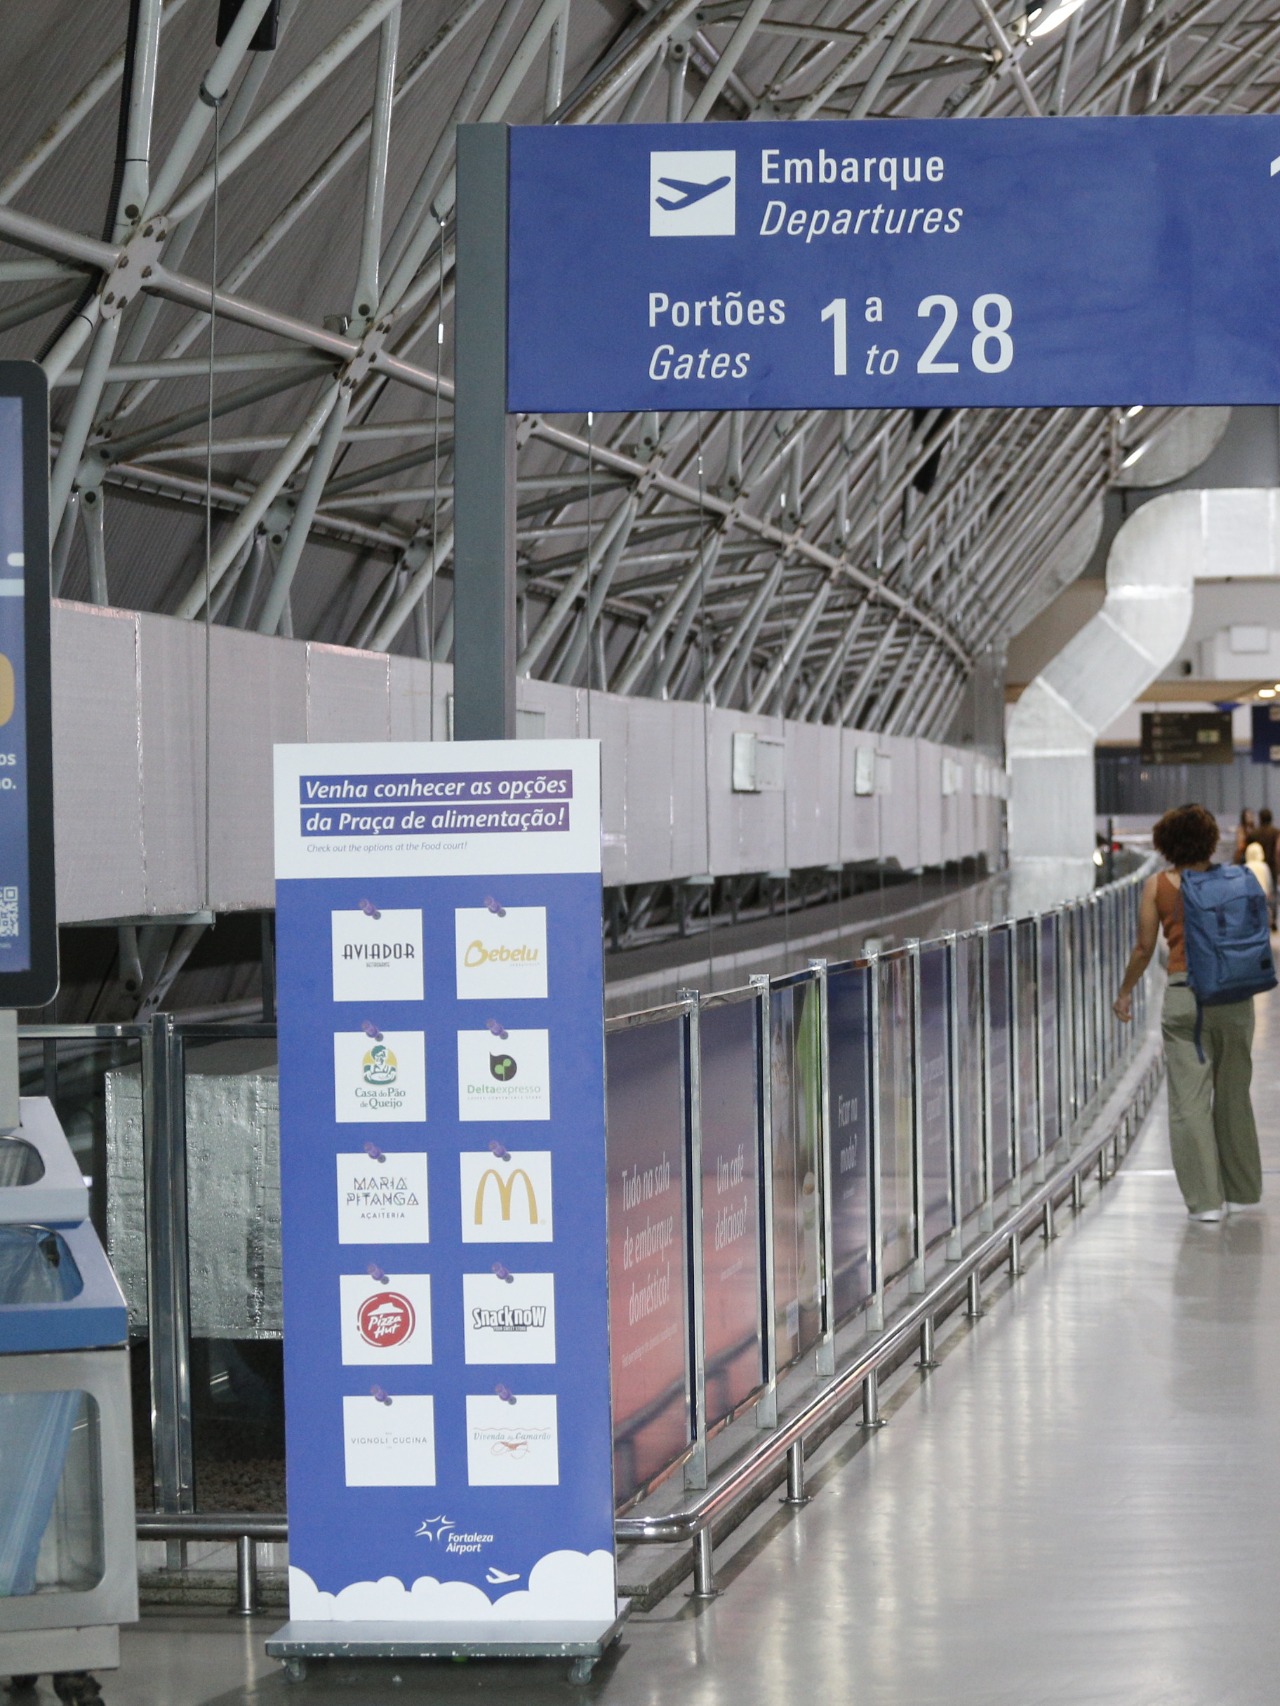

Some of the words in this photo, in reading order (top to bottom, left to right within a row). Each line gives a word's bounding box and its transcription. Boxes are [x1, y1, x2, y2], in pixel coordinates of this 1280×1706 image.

[761, 148, 944, 191] Embarque
[759, 200, 963, 243] Departures
[649, 291, 786, 328] Portões
[820, 298, 847, 376] 1
[917, 293, 1014, 374] 28
[649, 344, 750, 380] Gates
[865, 345, 899, 375] to
[0, 777, 17, 790] o.
[305, 780, 368, 799] Venha
[374, 778, 466, 798] conhecer
[470, 781, 492, 795] as
[498, 775, 567, 799] opções
[306, 813, 332, 831] da
[338, 812, 395, 835] Praça
[401, 811, 426, 829] de
[431, 807, 565, 832] alimentação!
[306, 843, 333, 853] Check
[333, 844, 346, 852] out
[348, 843, 361, 852] the
[363, 842, 393, 853] options
[395, 843, 406, 851] at
[406, 842, 419, 851] the
[421, 841, 441, 851] Food
[442, 841, 467, 850] court!
[341, 943, 415, 960] AVIADOR
[464, 940, 538, 968] Bebelu
[354, 1087, 377, 1098] Casa
[388, 1087, 406, 1098] Pão
[369, 1098, 403, 1109] Queijo
[716, 1154, 728, 1195] Um
[730, 1143, 744, 1188] café
[353, 1177, 408, 1190] MARIA
[621, 1163, 641, 1212] Tudo
[643, 1168, 653, 1200] na
[655, 1151, 670, 1195] sala
[346, 1192, 419, 1206] PITANGA
[623, 1225, 634, 1271] de
[635, 1214, 673, 1263] embarque
[628, 1260, 670, 1327] doméstico!
[367, 1314, 402, 1331] Pizza
[373, 1324, 401, 1339] Hut
[350, 1436, 388, 1445] VIGNOLI
[392, 1436, 427, 1444] CUCINA
[448, 1532, 494, 1543] Fortaleza
[445, 1543, 482, 1555] Airport
